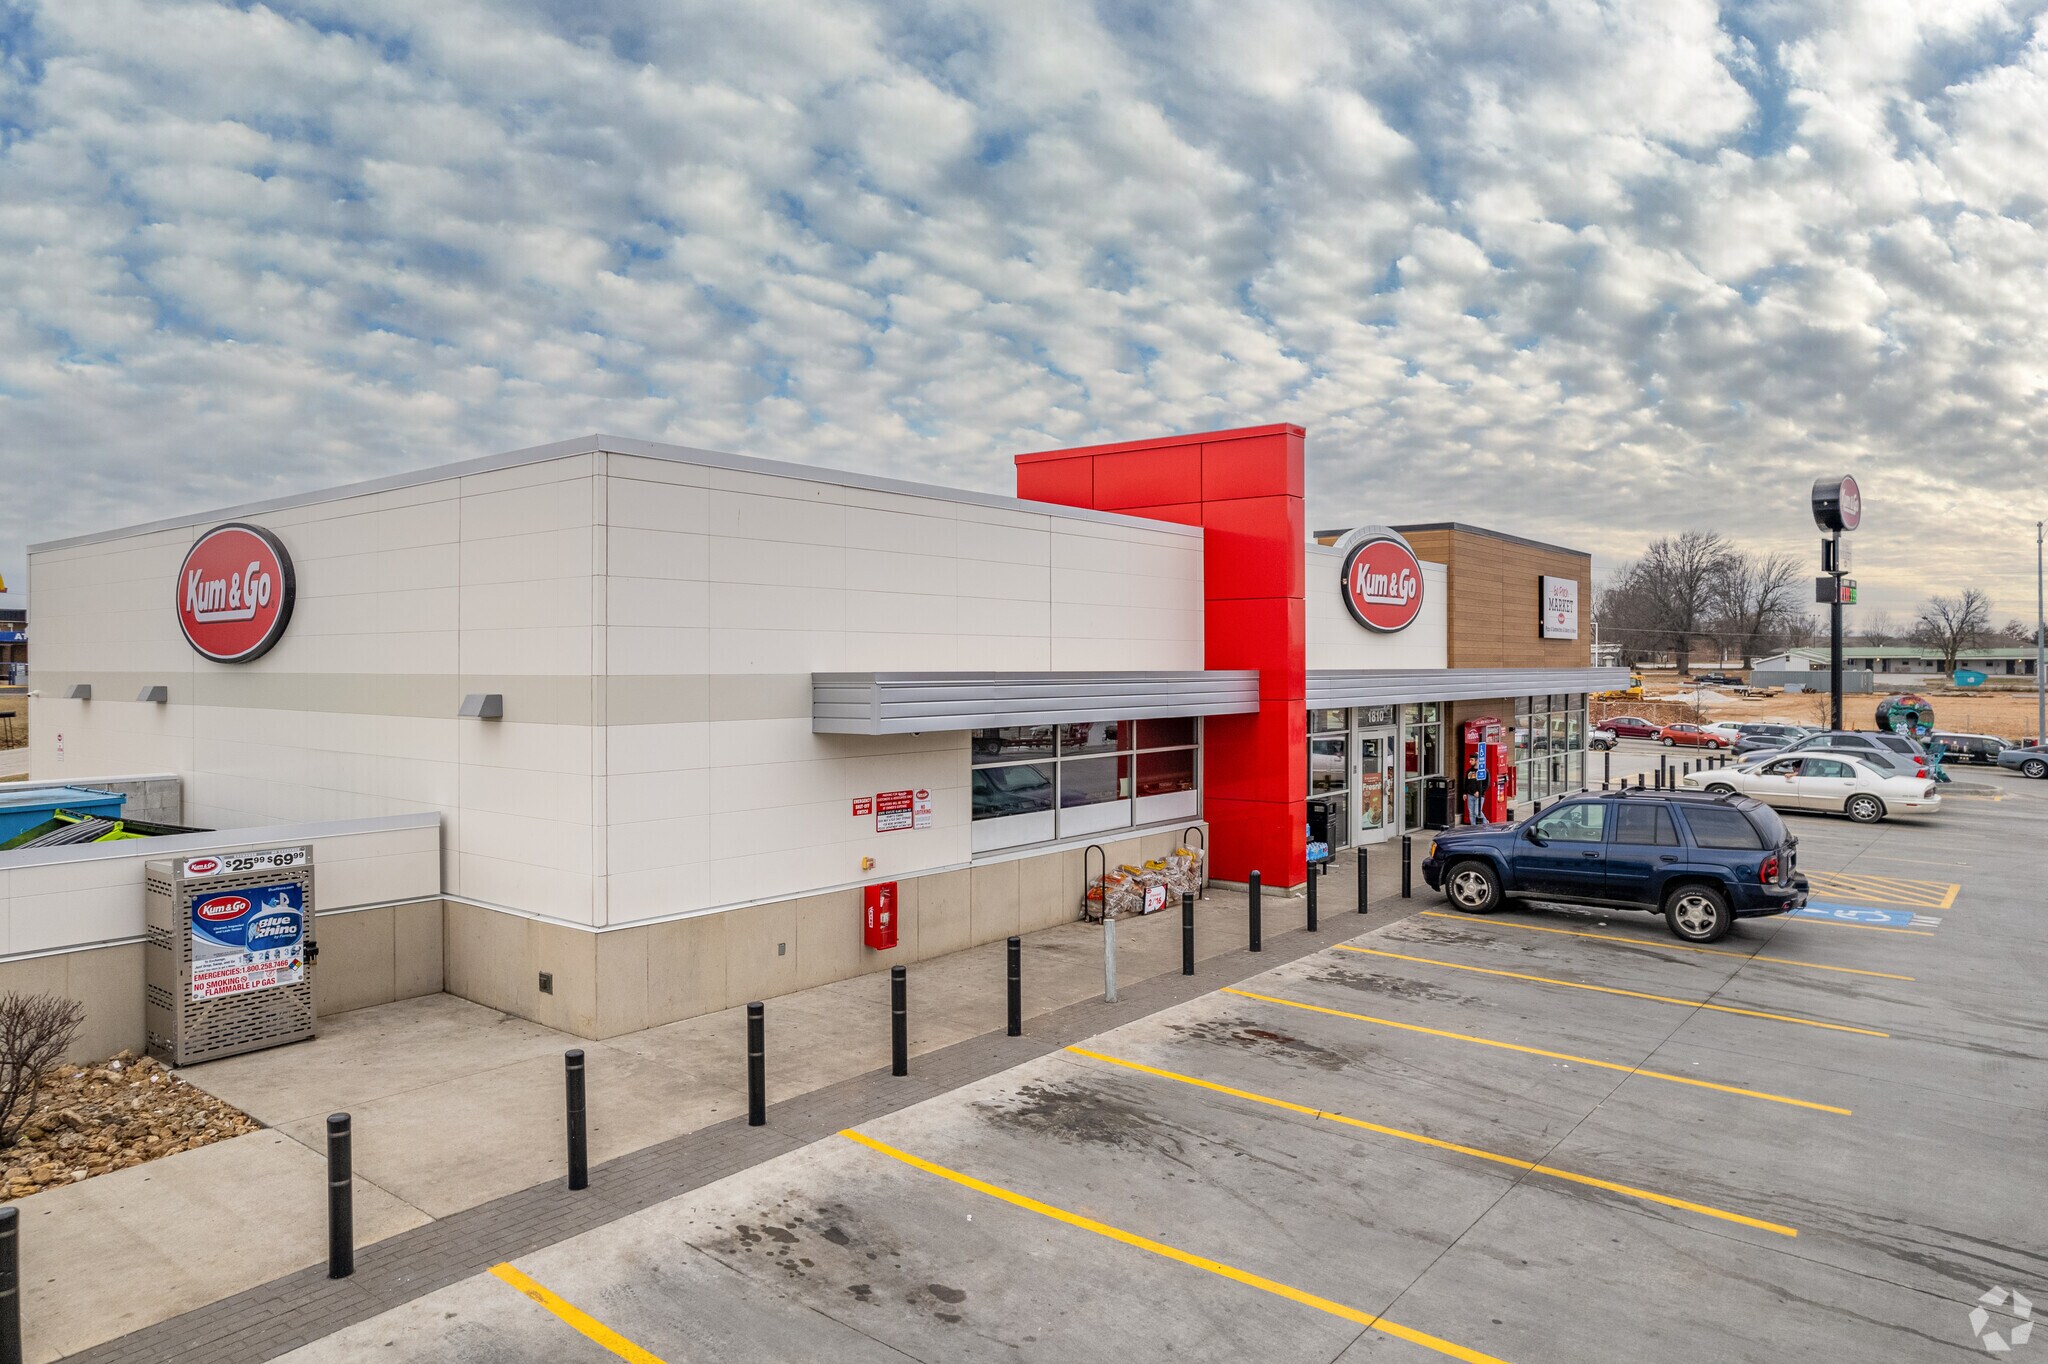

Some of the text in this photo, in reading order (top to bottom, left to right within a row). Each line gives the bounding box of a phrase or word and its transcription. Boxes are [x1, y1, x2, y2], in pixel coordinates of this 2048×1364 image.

[186, 561, 270, 620] Kum & Go
[1356, 563, 1416, 605] Kum & Go
[1548, 598, 1574, 613] MARKET
[1368, 710, 1384, 722] 1810
[202, 905, 224, 915] Kum
[232, 901, 246, 912] Go
[259, 917, 290, 927] Blue
[255, 925, 297, 939] Rhino
[194, 968, 242, 982] EMERGENCIES:
[194, 976, 240, 991] NO SMOKING
[205, 982, 250, 996] FLAMMABLE
[262, 978, 275, 986] GAS
